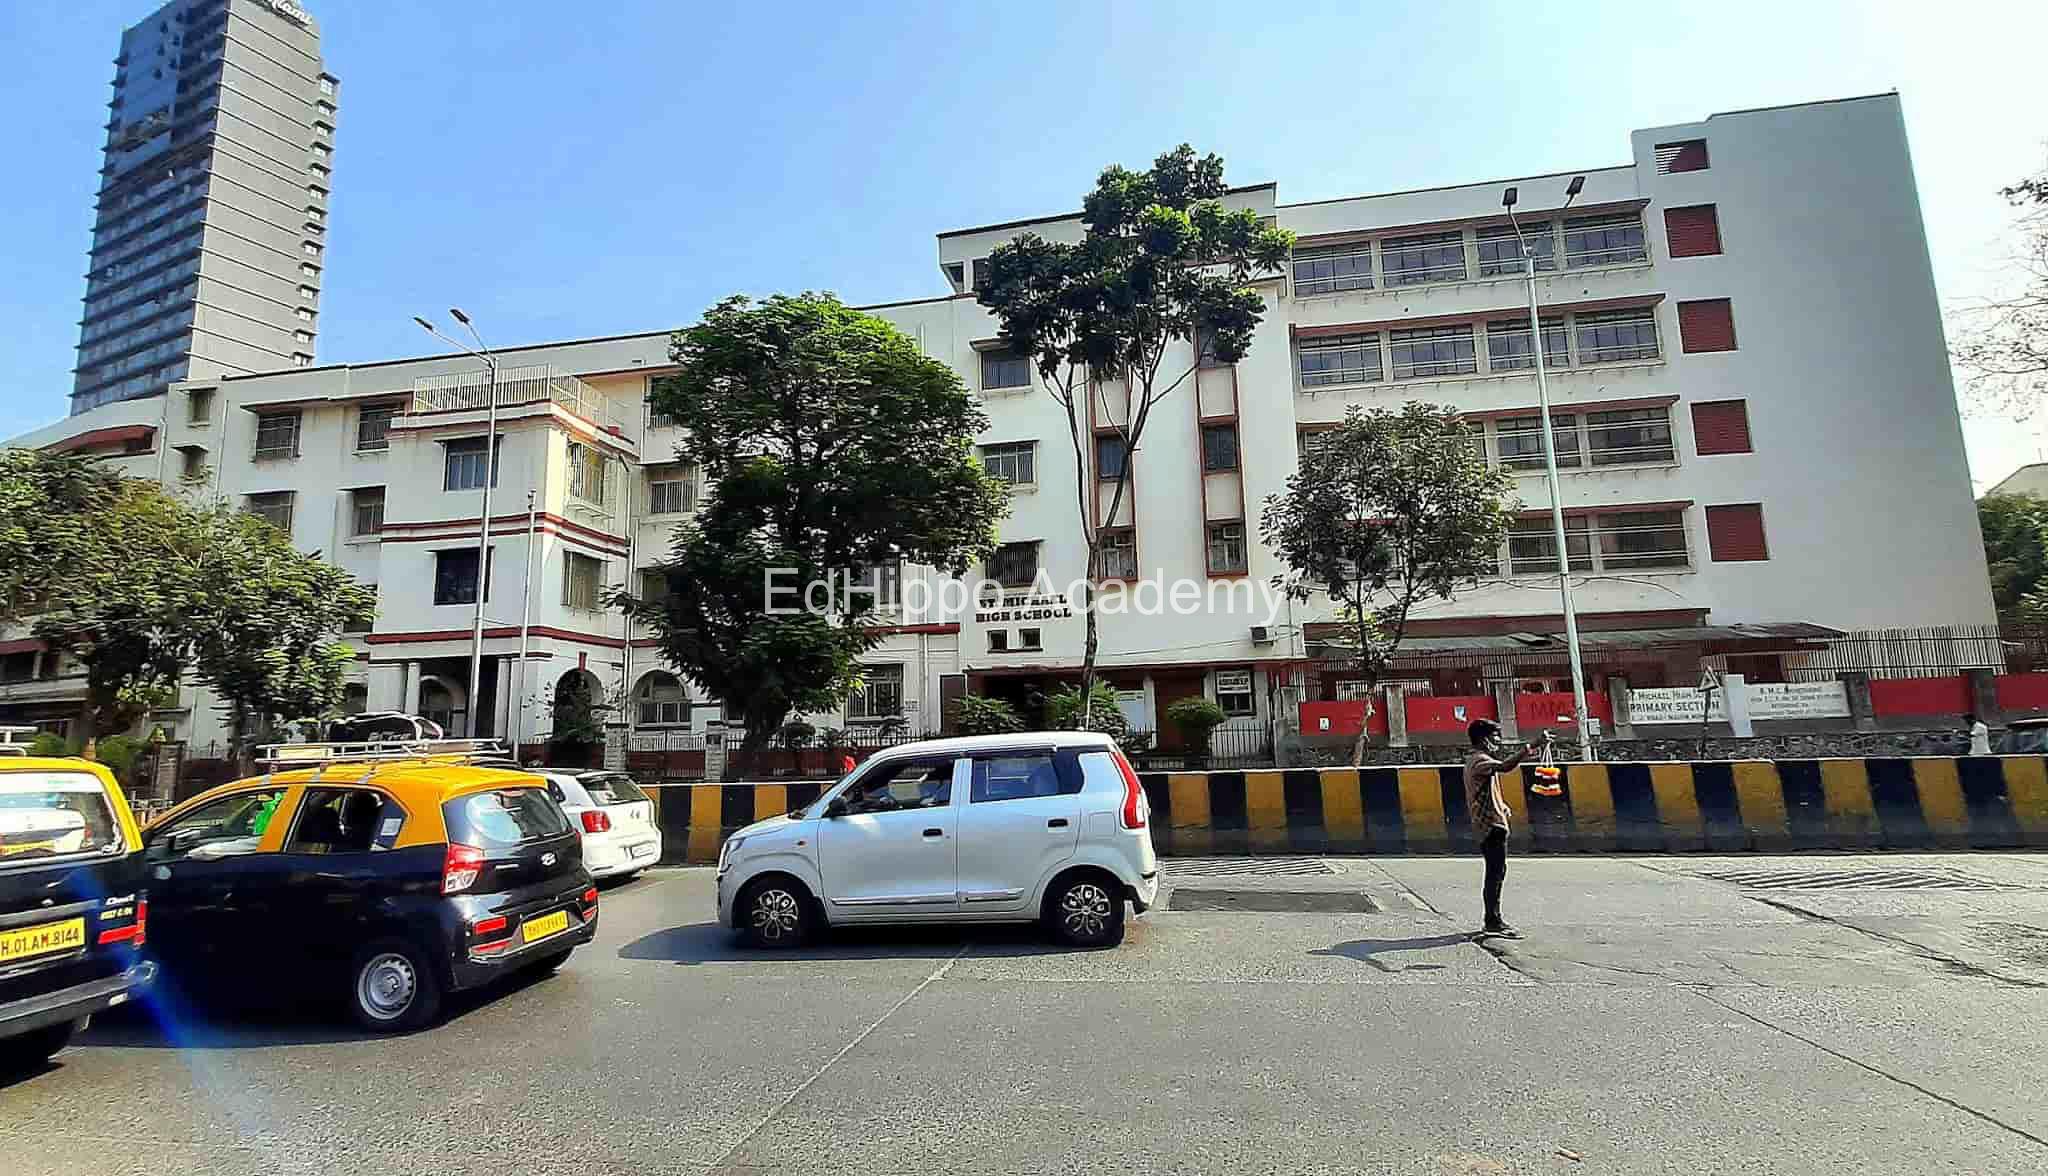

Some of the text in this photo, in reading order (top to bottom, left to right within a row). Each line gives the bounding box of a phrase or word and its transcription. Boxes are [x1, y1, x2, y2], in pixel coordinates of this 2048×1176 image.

[1003, 595, 1067, 607] MICHAL
[976, 608, 1072, 623] HIGH SCHOOL
[1630, 700, 1720, 713] PRIMARY SECTIN
